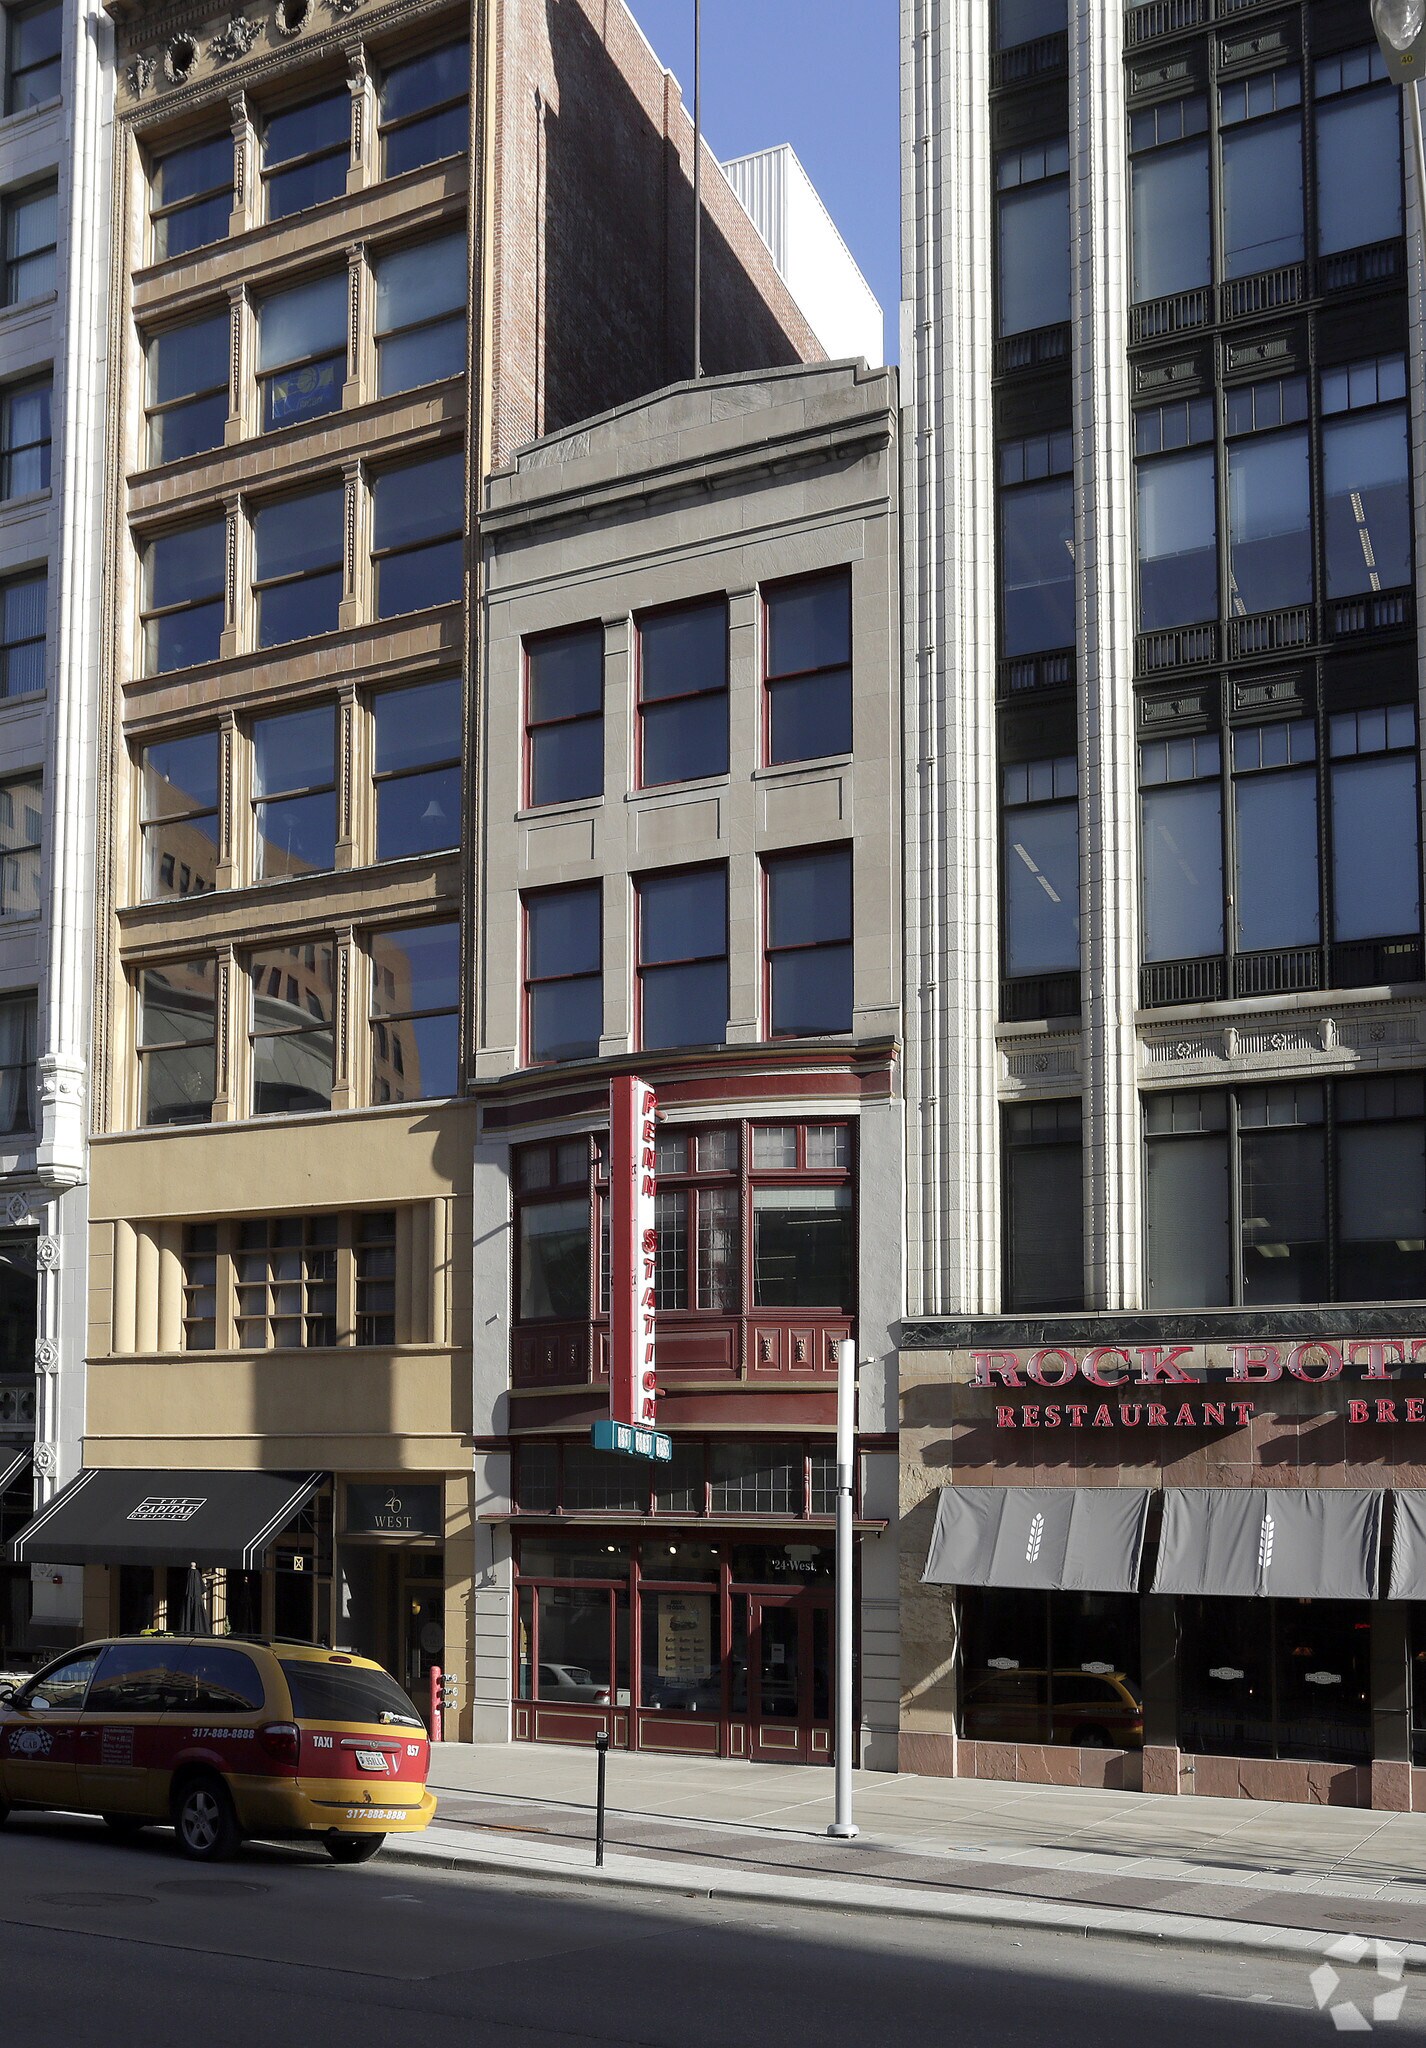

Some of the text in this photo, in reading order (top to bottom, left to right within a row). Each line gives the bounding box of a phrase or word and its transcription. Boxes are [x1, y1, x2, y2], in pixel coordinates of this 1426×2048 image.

[1401, 55, 1413, 63] 40
[641, 1090, 658, 1420] PENN STATION
[968, 1341, 1426, 1387] ROCK BOT
[996, 1397, 1426, 1428] RESTAURANT BRE
[385, 1488, 402, 1513] 26
[137, 1505, 194, 1513] CAPITAL
[374, 1515, 411, 1528] WEST
[192, 1727, 255, 1739] 317-888-8888
[22, 1740, 38, 1748] CAB
[313, 1736, 333, 1748] TAXI
[406, 1745, 420, 1756] 857
[346, 1809, 407, 1820] 317-888-8888
